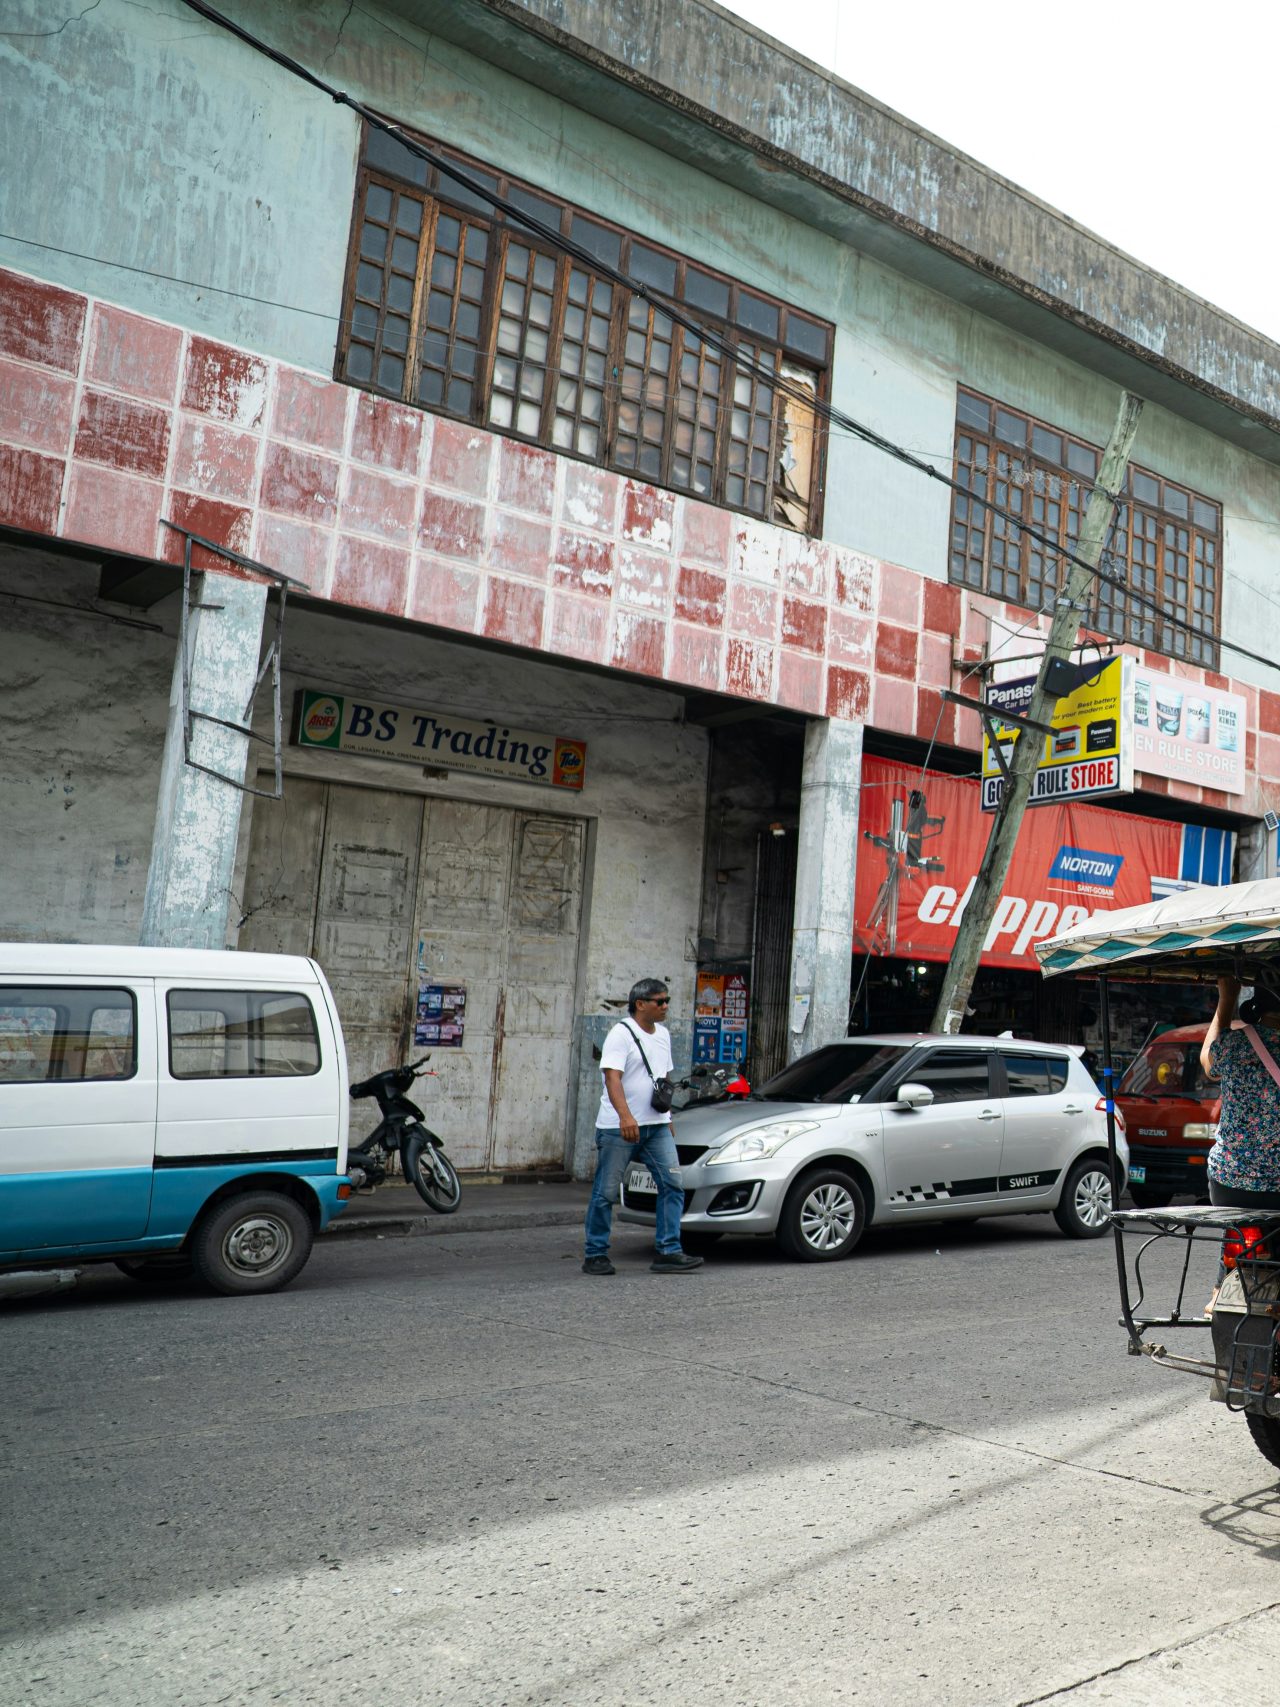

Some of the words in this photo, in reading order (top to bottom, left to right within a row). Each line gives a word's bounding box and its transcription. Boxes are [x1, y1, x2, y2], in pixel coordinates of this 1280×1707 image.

[1004, 702, 1017, 710] Car
[1077, 700, 1094, 709] Best
[1094, 696, 1118, 706] battery
[1062, 711, 1077, 720] your
[1078, 706, 1104, 716] modern
[1105, 703, 1117, 711] car.
[307, 714, 336, 727] ARIEL
[1090, 726, 1113, 736] Panasonic
[345, 704, 400, 743] BS
[412, 715, 552, 777] Trading
[559, 752, 581, 769] Tide
[1158, 744, 1193, 764] RULE
[1196, 751, 1238, 773] STORE
[1037, 768, 1069, 795] RULE
[1071, 760, 1114, 791] STORE
[1060, 855, 1115, 878] NORTON
[1138, 1128, 1168, 1137] SUZUKI
[630, 1175, 643, 1188] NAY
[1009, 1175, 1039, 1188] SWIFT
